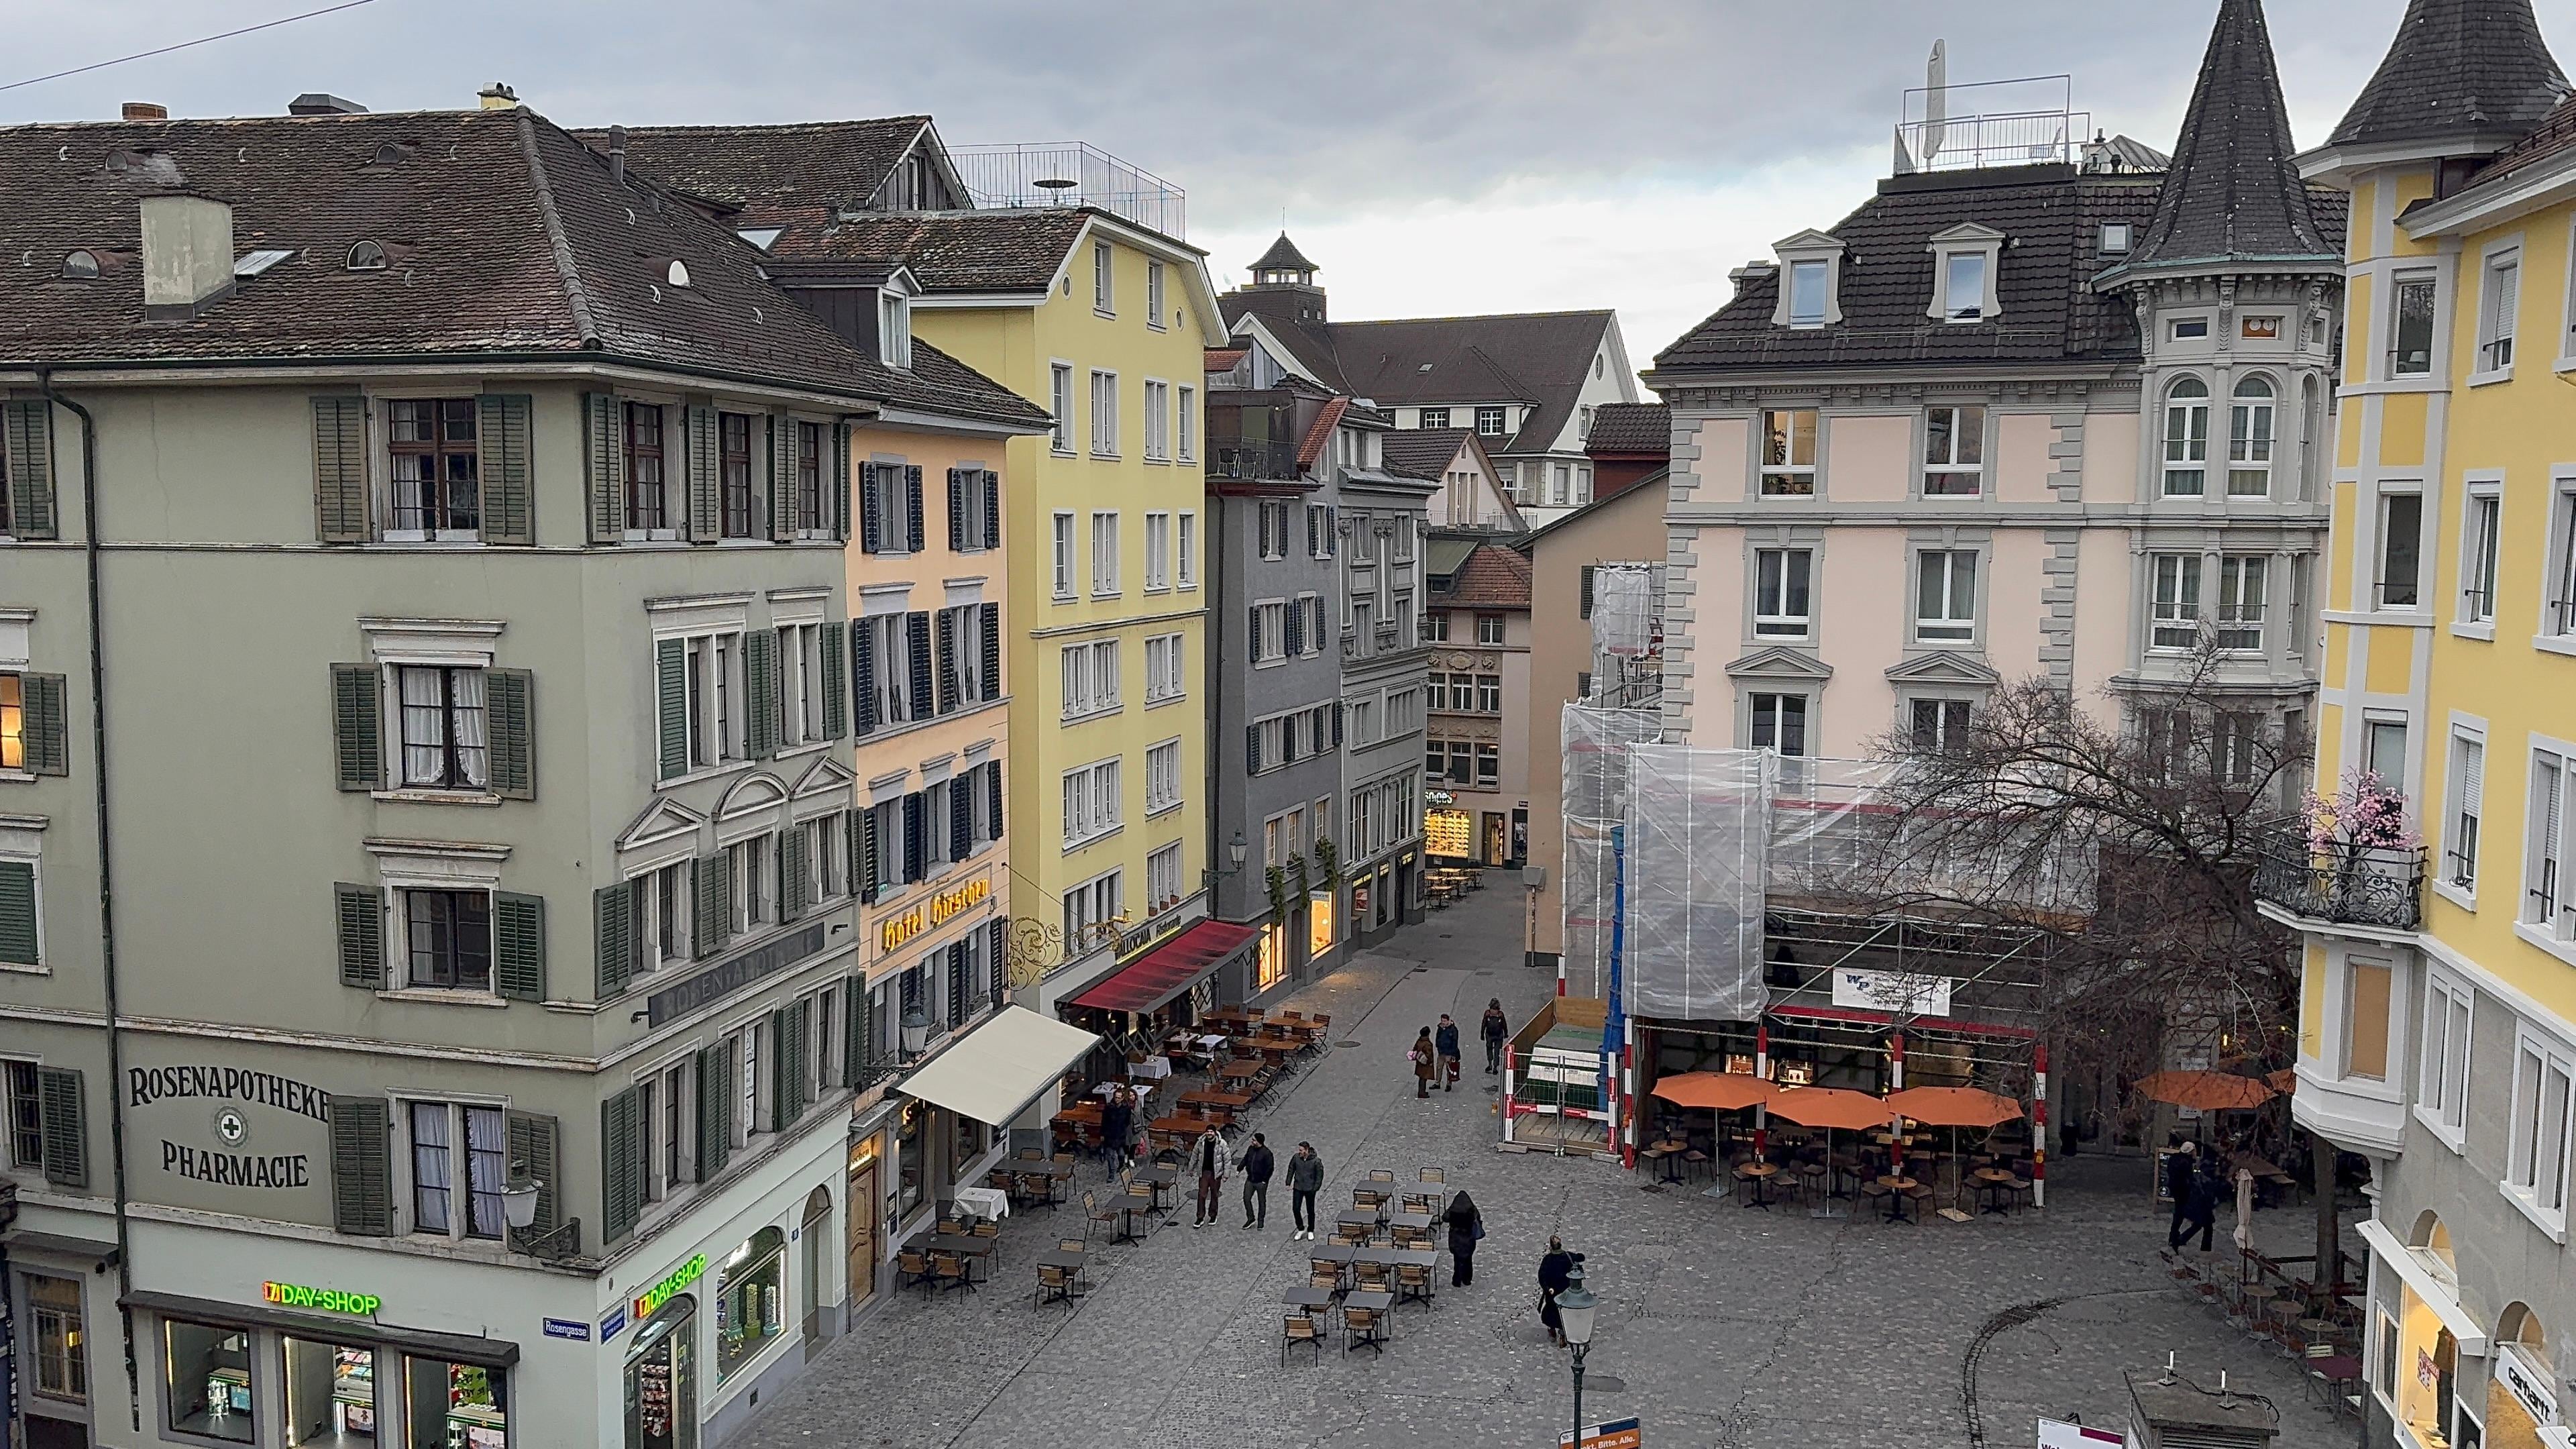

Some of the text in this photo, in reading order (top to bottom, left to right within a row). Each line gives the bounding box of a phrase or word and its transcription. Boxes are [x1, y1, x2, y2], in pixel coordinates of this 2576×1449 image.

[882, 878, 989, 952] Hotel Hirschen
[128, 1066, 331, 1123] ROSENAPOTHEKE
[161, 1139, 309, 1187] PHARMACIE
[545, 1320, 588, 1336] Rosengasse
